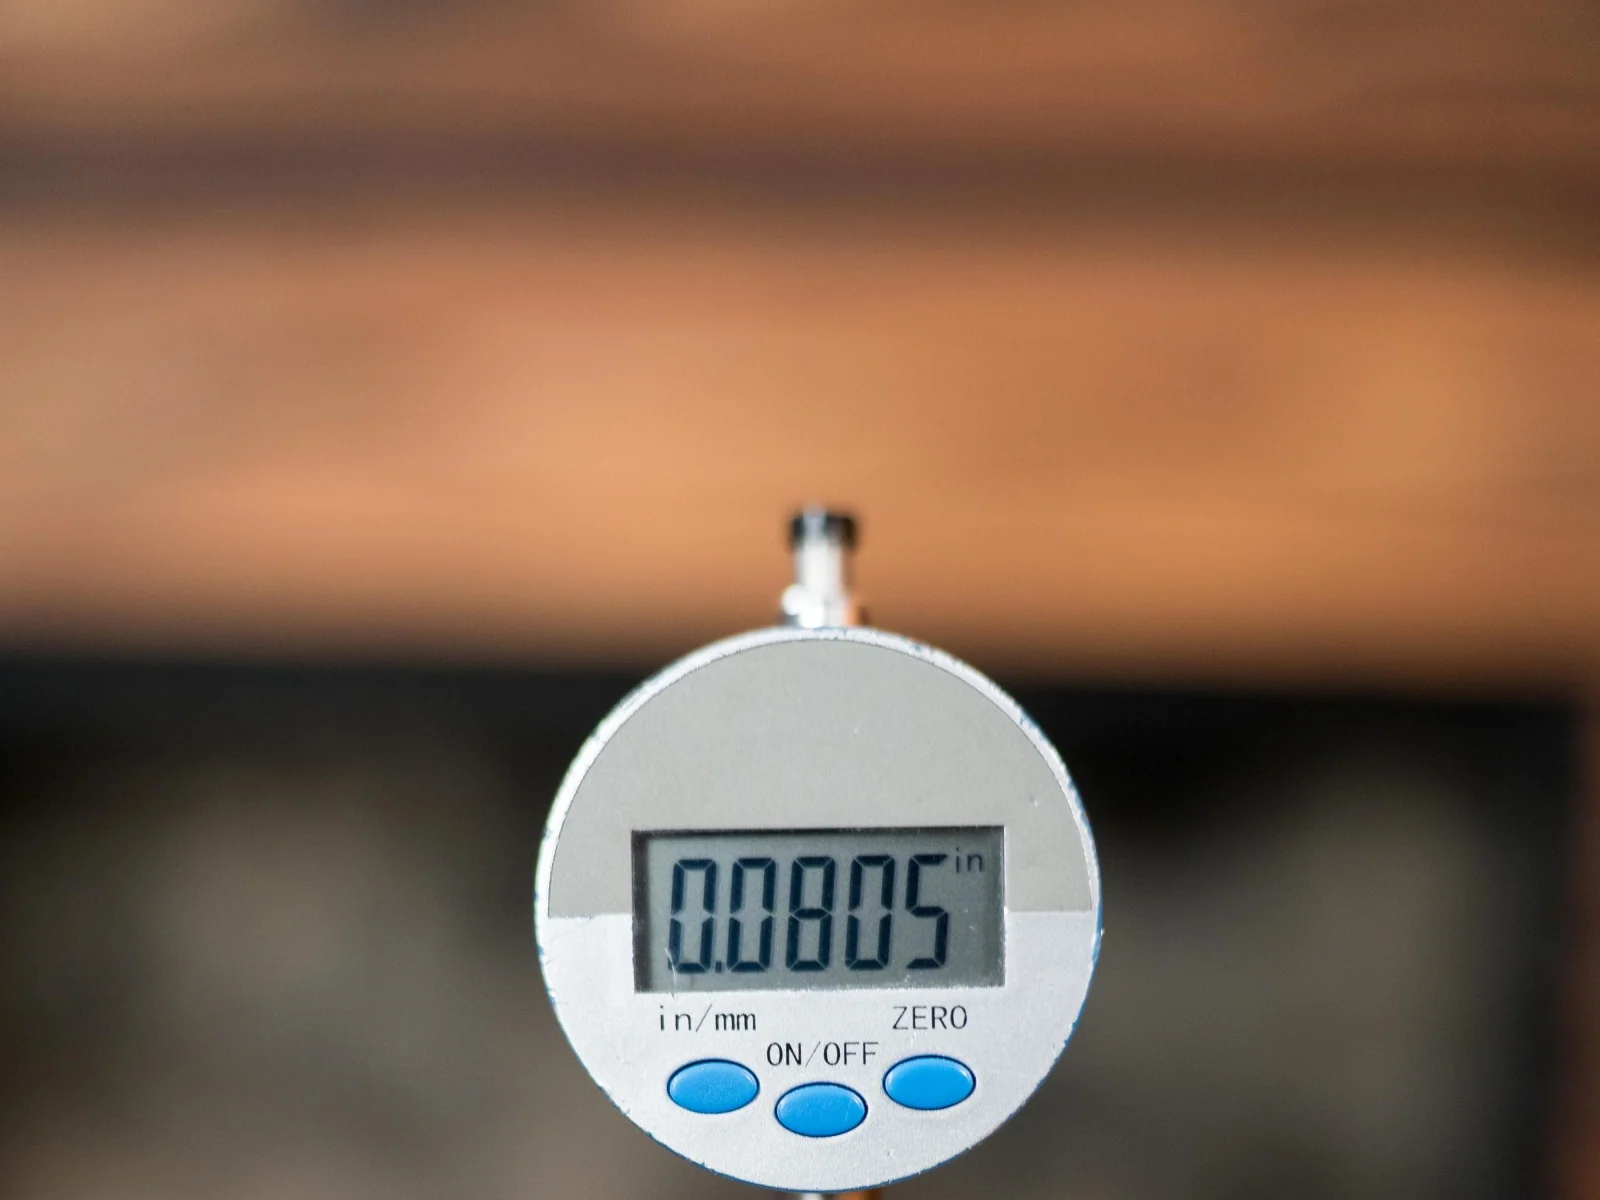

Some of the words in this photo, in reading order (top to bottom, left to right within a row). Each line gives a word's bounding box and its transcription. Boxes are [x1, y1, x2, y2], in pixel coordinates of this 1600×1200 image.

[668, 855, 949, 974] 0.0805
[955, 847, 985, 873] in
[660, 1005, 756, 1032] in/mm
[892, 1006, 968, 1030] ZERO
[766, 1042, 878, 1066] ON/OFF
